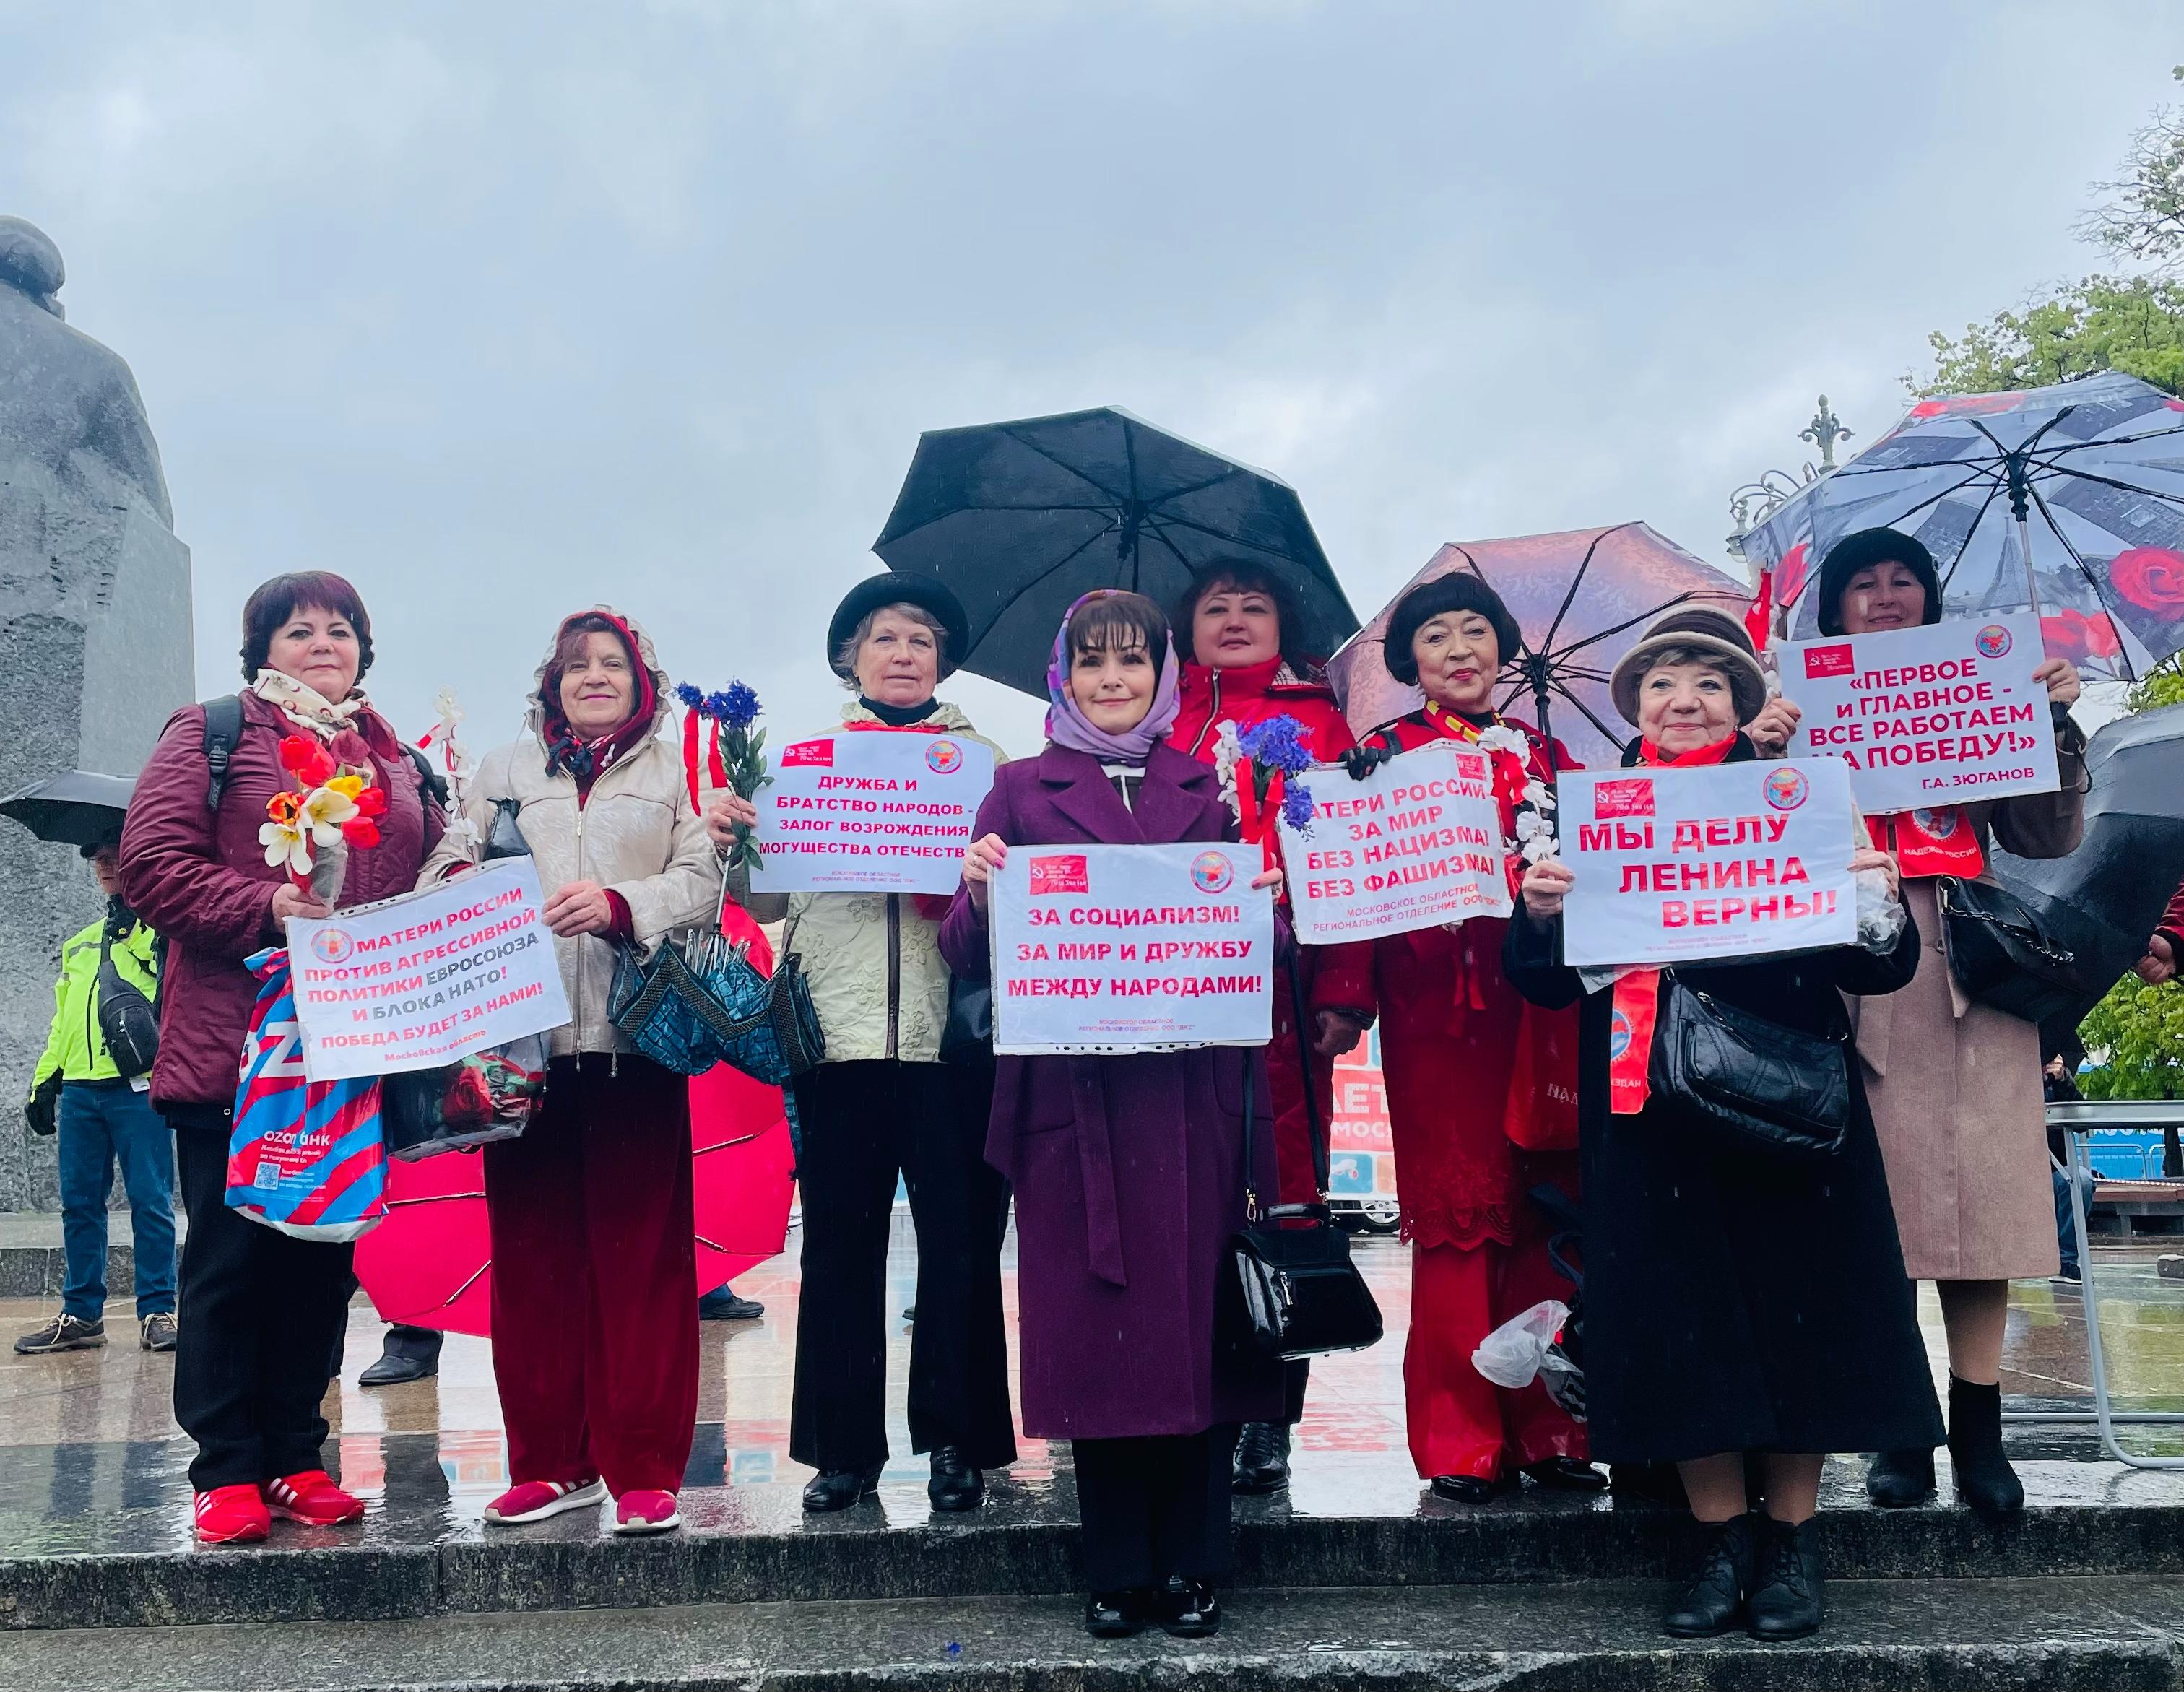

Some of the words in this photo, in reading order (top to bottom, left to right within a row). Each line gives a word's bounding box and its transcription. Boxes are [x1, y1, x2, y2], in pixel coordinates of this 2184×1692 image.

[1850, 658, 1978, 690] «ПЕРВОЕ
[1860, 682, 1994, 716] ГЛАВНОЕ
[1809, 724, 1865, 747] ВСЕ
[1873, 703, 2034, 739] РАБОТАЕМ
[1812, 750, 1861, 770] А
[1867, 731, 2036, 769] ПОБЕДУ!»
[818, 776, 898, 791] ДРУЖБА
[904, 779, 918, 791] И
[1922, 777, 1949, 789] Г.А.
[1953, 768, 2034, 786] ЗЮГАНОВ
[776, 796, 878, 813] БРАТСТВО
[883, 802, 963, 816] НАРОДОВ
[1310, 793, 1385, 820] АТЕРИ
[1392, 778, 1487, 807] РОССИИ
[779, 819, 835, 832] ЗАЛОГ
[839, 820, 969, 838] ВОЗРОЖДЕНИЯ
[1348, 823, 1383, 841] ЗА
[1387, 804, 1444, 833] МИР
[1579, 821, 1655, 851] МЫ
[1671, 813, 1790, 854] ДЕЛУ
[759, 841, 872, 855] МОГУЩЕСТВА
[877, 844, 966, 859] ОТЕЧЕСТВ
[1307, 849, 1356, 870] БЕЗ
[1363, 826, 1490, 864] НАЦИЗМА!
[1306, 877, 1356, 899] БЕЗ
[1363, 853, 1495, 892] ФАШИЗМА!
[1618, 856, 1811, 893] ЛЕНИНА
[1028, 908, 1062, 927] ЗА
[1069, 905, 1239, 929] СОЦИАЛИЗМ!
[1313, 915, 1394, 932] РЕГИОНАЛЬНОЕ
[1396, 899, 1457, 921] ОТДЕЛЕНИЕ
[1346, 896, 1416, 918] МОСКОВСКОЕ
[1419, 882, 1480, 903] ОБЛАСТНОЕ
[1662, 889, 1837, 928] ВЕРНЫ!
[356, 916, 441, 954] МАТЕРИ
[446, 887, 524, 928] РОССИИ
[304, 960, 393, 982] ПРОТИВ
[396, 907, 537, 971] АГРЕССИВНОЙ
[1016, 943, 1050, 961] ЗА
[1057, 942, 1112, 961] МИР
[1120, 943, 1137, 961] И
[1145, 940, 1253, 964] ДРУЖБУ
[307, 974, 424, 1003] ПОЛИТИКИ
[425, 931, 540, 986] ЕВРОСОЮЗА
[352, 1009, 368, 1023] И
[372, 992, 446, 1020] БЛОКА
[448, 966, 508, 999] НАТО!
[1008, 978, 1103, 999] МЕЖДУ
[1110, 975, 1262, 998] НАРОДАМИ!
[321, 1031, 399, 1049] ПОБЕДА
[403, 1014, 459, 1041] БУДЕТ
[462, 1005, 484, 1023] ЗА
[486, 981, 545, 1013] НАМИ!
